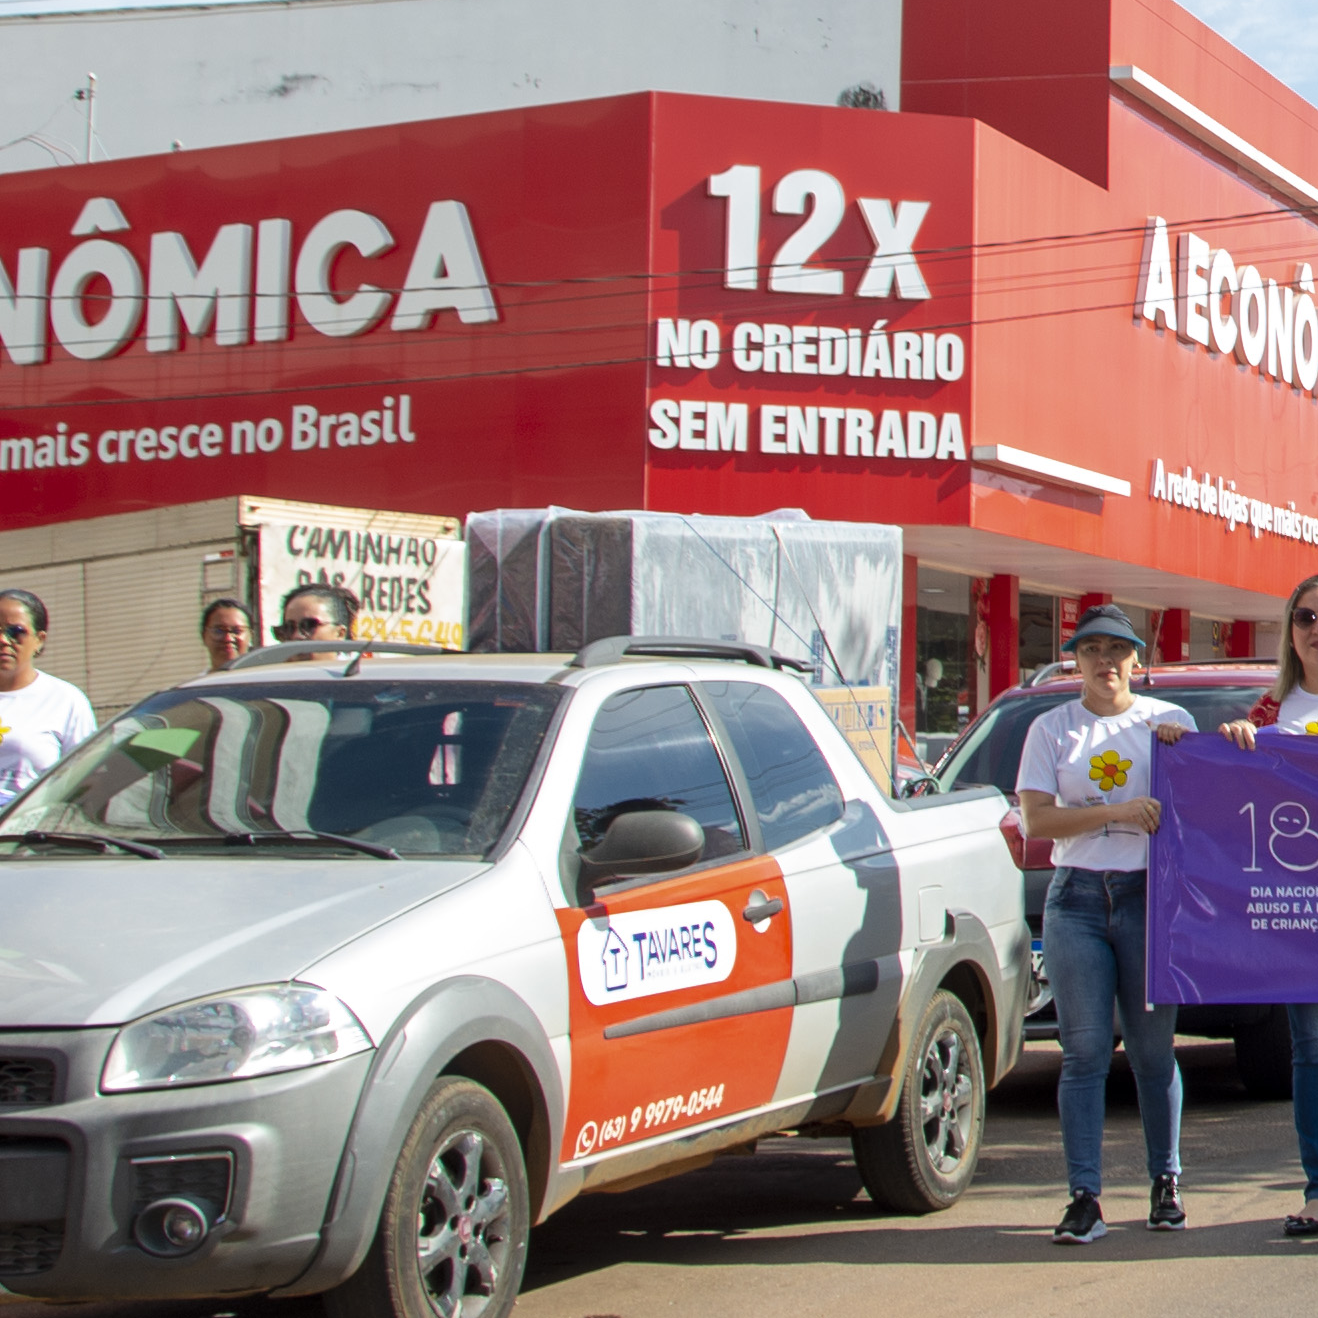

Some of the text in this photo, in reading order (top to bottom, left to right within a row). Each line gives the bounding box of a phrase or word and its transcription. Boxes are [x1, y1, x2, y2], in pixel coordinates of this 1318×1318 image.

[1135, 215, 1178, 332] A
[656, 318, 965, 382] NO CREDIÁRIO
[0, 395, 415, 471] mais cresce no Brasil
[648, 399, 968, 461] SEM ENTRADA
[1168, 466, 1199, 510] rede
[1200, 472, 1217, 515] de
[1218, 476, 1249, 531] lojas
[1250, 498, 1272, 539] que
[1273, 501, 1302, 540] mais
[360, 571, 432, 615] REDES
[1246, 901, 1290, 914] ABUSO
[1293, 901, 1300, 913] E
[1303, 898, 1314, 914] À
[1250, 886, 1272, 898] DIA
[632, 921, 718, 981] TAVARES
[1251, 917, 1269, 930] DE
[599, 1083, 725, 1147] (63) 9 9979-0544
